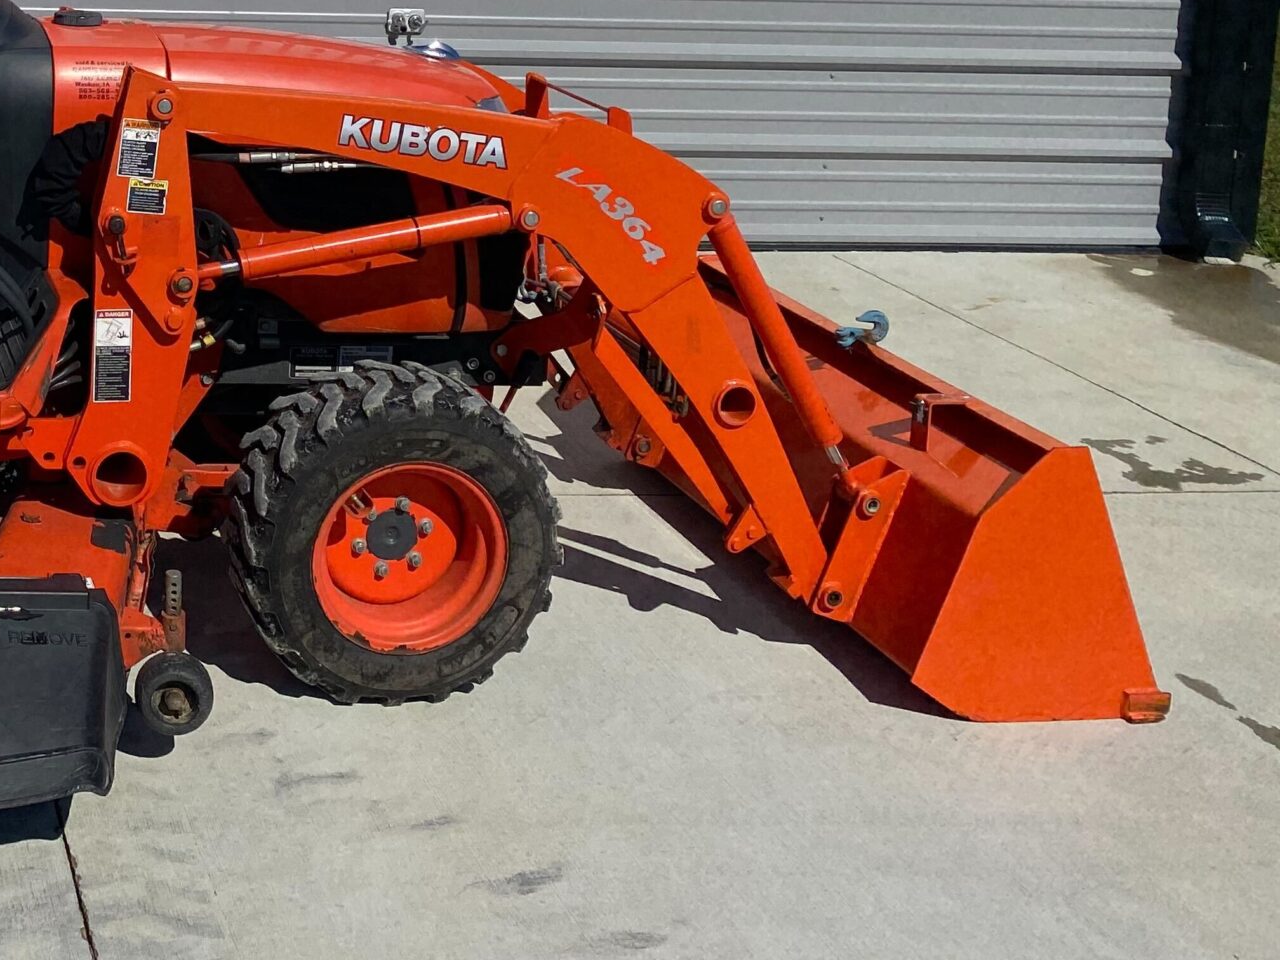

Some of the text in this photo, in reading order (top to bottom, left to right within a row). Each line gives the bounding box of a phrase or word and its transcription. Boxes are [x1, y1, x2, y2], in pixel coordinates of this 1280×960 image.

[337, 114, 508, 170] KUBOTA
[554, 167, 666, 265] LA364
[8, 630, 89, 647] REMOVE
